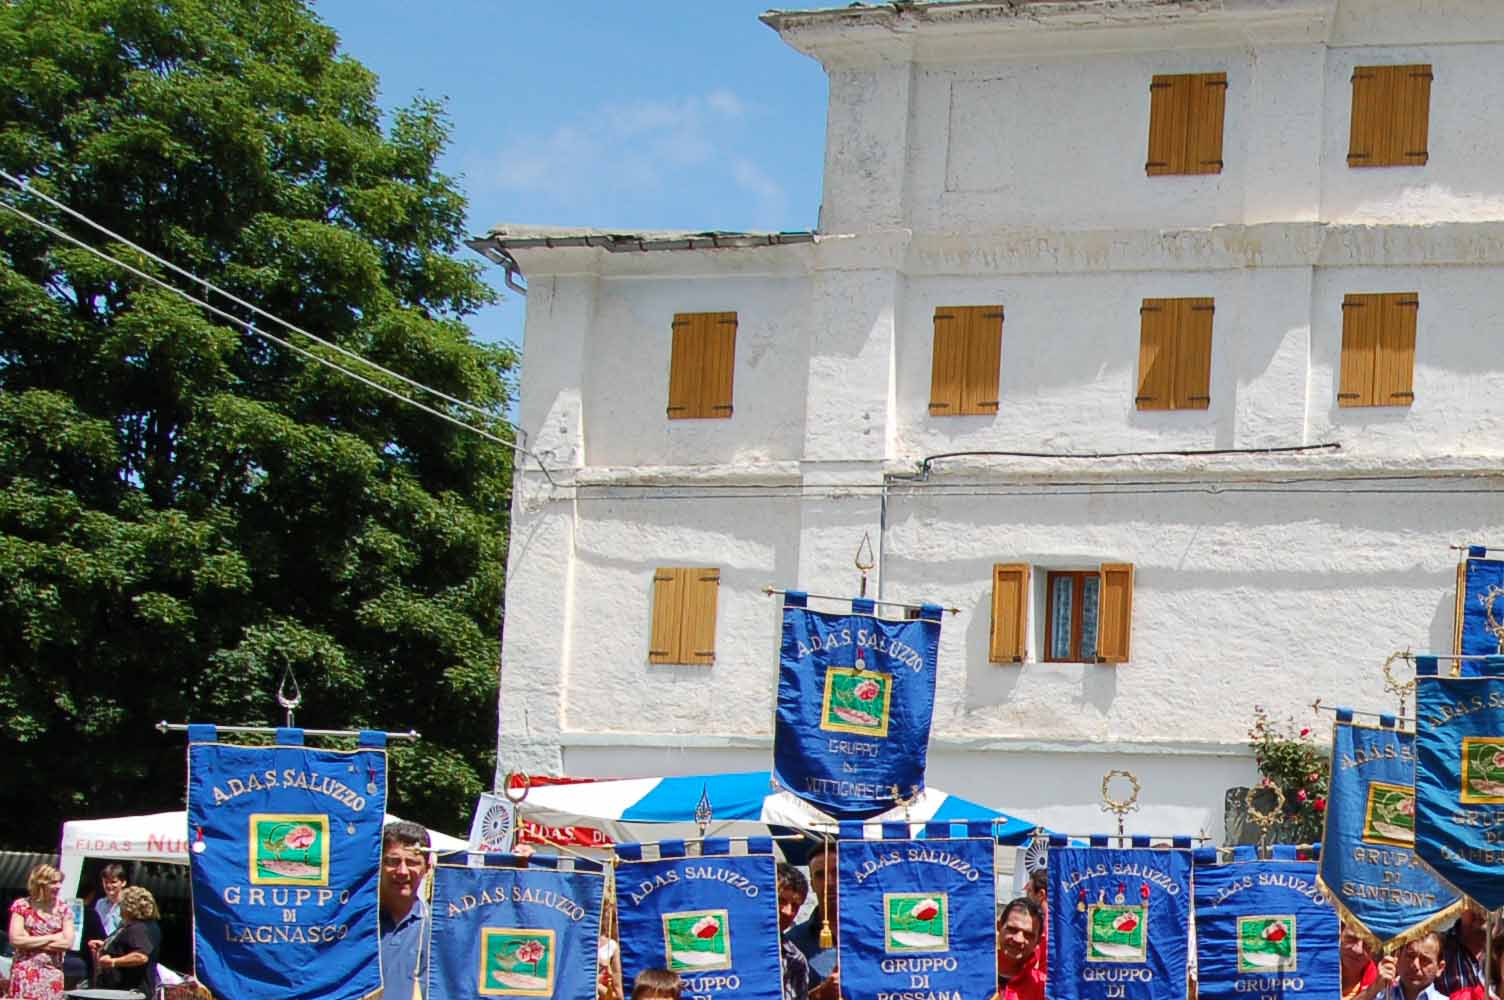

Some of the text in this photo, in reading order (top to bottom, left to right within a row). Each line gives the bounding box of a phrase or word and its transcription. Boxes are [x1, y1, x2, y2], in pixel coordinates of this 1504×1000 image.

[857, 628, 924, 674] SALUZZO
[828, 737, 880, 758] GRUPPO
[282, 767, 367, 812] SALUZZO
[907, 848, 981, 883] SALUZZO
[684, 865, 760, 899] SALUZZO
[1112, 862, 1181, 896] SALUZZO
[1258, 872, 1326, 907] SALUZZO
[223, 885, 351, 907] GRUPPO
[511, 885, 586, 922] SALUZZO
[282, 908, 298, 924] DI
[224, 924, 349, 945] LAGNASCO
[880, 956, 959, 974] GRUPPO
[1082, 967, 1154, 983] GRUPPO
[680, 974, 741, 993] RUPPO
[909, 974, 931, 990] DI
[1106, 984, 1127, 999] DI
[1234, 976, 1305, 994] GRUPPO
